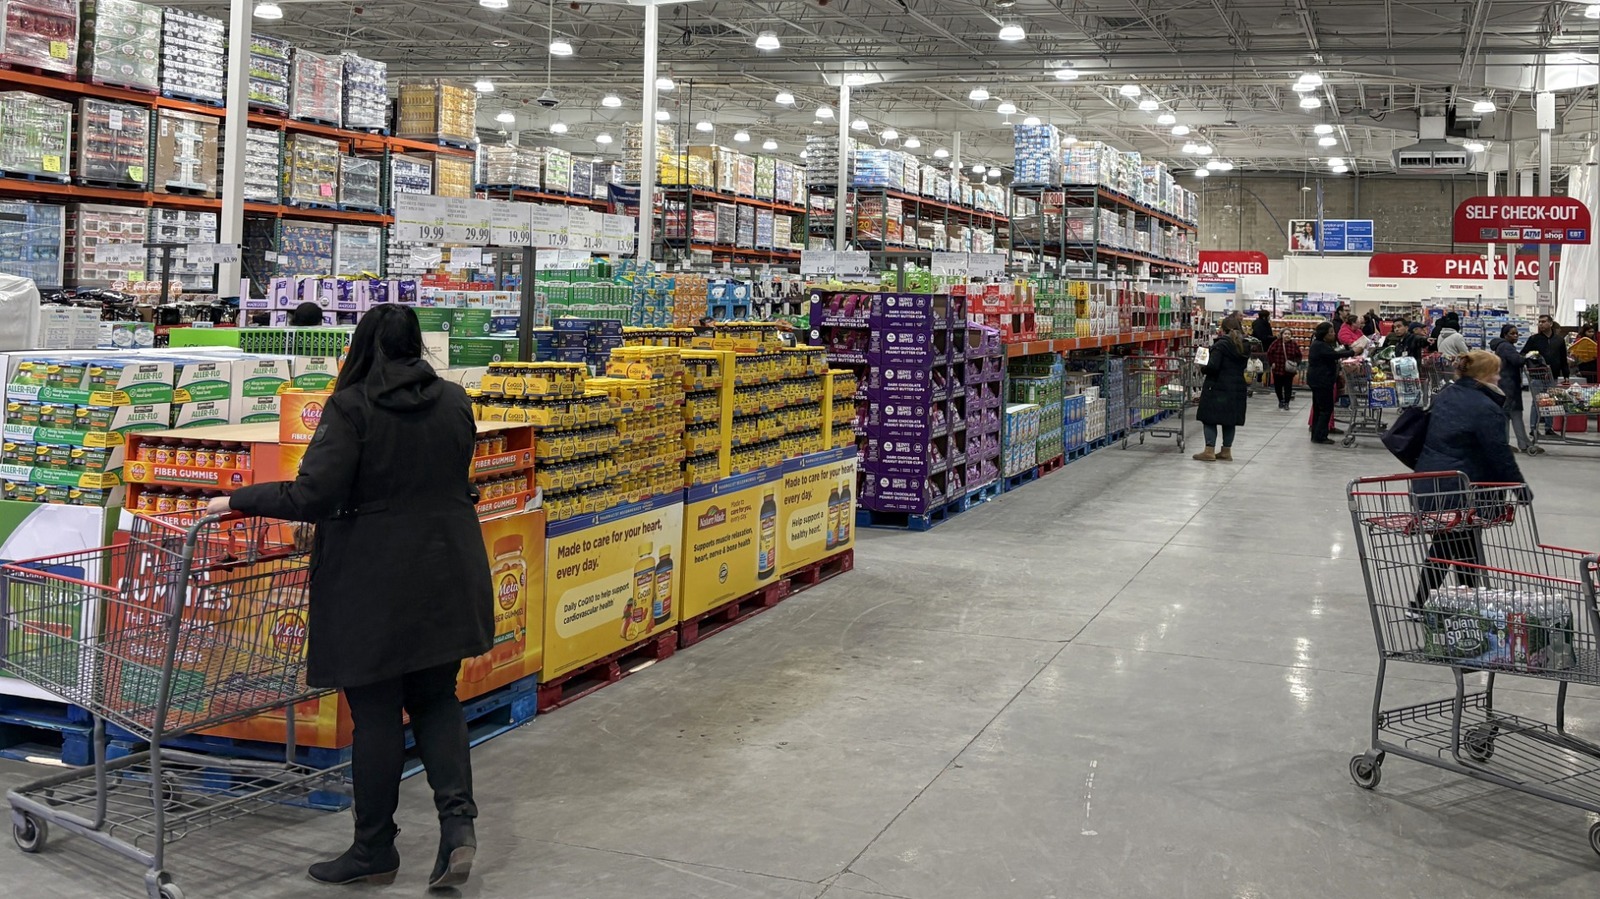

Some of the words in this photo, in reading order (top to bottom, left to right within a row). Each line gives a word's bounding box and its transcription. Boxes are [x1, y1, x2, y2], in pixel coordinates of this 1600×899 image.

[1466, 205, 1498, 220] SELF
[1501, 205, 1579, 220] CHECK-OUT
[420, 226, 444, 239] 19.99
[466, 228, 488, 240] 29.99
[509, 231, 530, 242] 19.99
[1544, 232, 1563, 240] shop
[548, 234, 568, 246] 17.99
[584, 237, 602, 248] 21.49
[618, 240, 633, 251] 13.99
[1202, 262, 1219, 273] AID
[1222, 262, 1262, 274] CENTER
[132, 372, 164, 380] ALLER-FLO
[192, 370, 221, 379] ALLER-FLO
[8, 386, 38, 394] ALLER-FLO
[128, 412, 158, 421] ALLER-FLO
[192, 409, 219, 418] ALLER-FLO
[5, 425, 33, 434] ALLER-FLO
[475, 460, 490, 468] FIBER
[492, 454, 516, 465] GUMMIES
[800, 458, 806, 467] #1
[0, 466, 30, 475] ALLER-FLO
[154, 468, 177, 476] FIBER
[180, 469, 218, 480] GUMMIES
[784, 475, 801, 489] Made
[802, 474, 808, 484] to
[808, 472, 820, 483] care
[820, 470, 829, 480] for
[829, 468, 841, 480] your
[841, 464, 854, 474] heart,
[711, 484, 718, 494] #1
[477, 503, 492, 512] FIBER
[493, 498, 518, 508] GUMMIES
[784, 493, 800, 506] every
[592, 514, 600, 524] #1
[730, 514, 740, 524] every
[792, 516, 803, 528] Help
[803, 512, 820, 524] support
[558, 542, 580, 560] Made
[582, 540, 592, 552] to
[592, 534, 610, 550] care
[612, 530, 624, 543] for
[624, 526, 641, 542] your
[642, 520, 662, 535] heart,
[694, 540, 716, 552] Supports
[716, 534, 731, 545] muscle
[731, 528, 753, 542] relaxation,
[790, 530, 808, 542] healthy
[694, 553, 708, 564] heart,
[708, 550, 722, 558] nerve
[726, 544, 738, 553] bone
[738, 538, 751, 549] health
[556, 562, 581, 580] every
[500, 582, 519, 596] Meta
[658, 582, 669, 592] CoQ10
[564, 598, 577, 612] Daily
[578, 596, 594, 608] CoQ10
[594, 593, 600, 601] to
[600, 589, 612, 601] help
[612, 583, 630, 596] support
[637, 588, 651, 600] CoQ10
[504, 608, 523, 620] GUMMIES
[563, 606, 598, 625] cardiovascular
[599, 600, 614, 611] health
[271, 622, 304, 637] Meta
[1446, 628, 1484, 646] Spring
